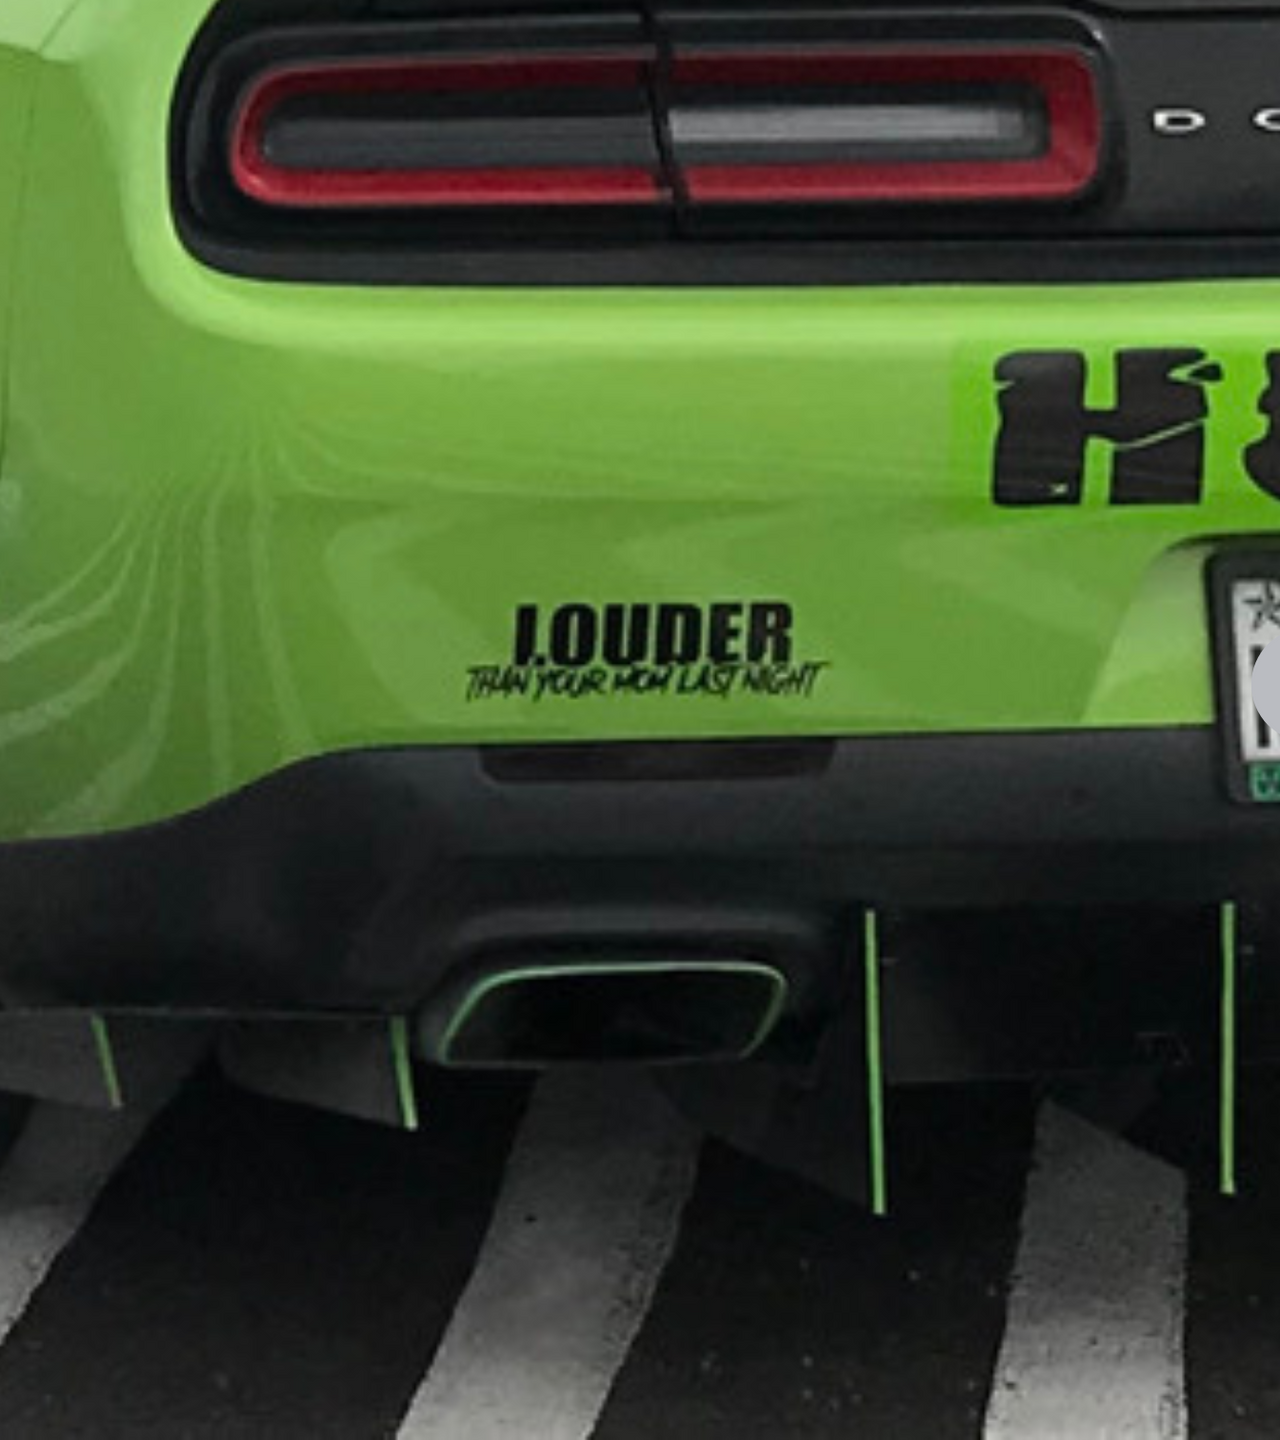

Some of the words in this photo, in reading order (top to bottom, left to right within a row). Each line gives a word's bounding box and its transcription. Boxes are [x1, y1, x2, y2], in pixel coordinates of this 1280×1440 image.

[514, 602, 794, 667] LOUDER
[466, 664, 529, 702] THAN
[532, 664, 608, 702] YOUR
[675, 662, 739, 699] LAST
[740, 661, 830, 697] NIGHT
